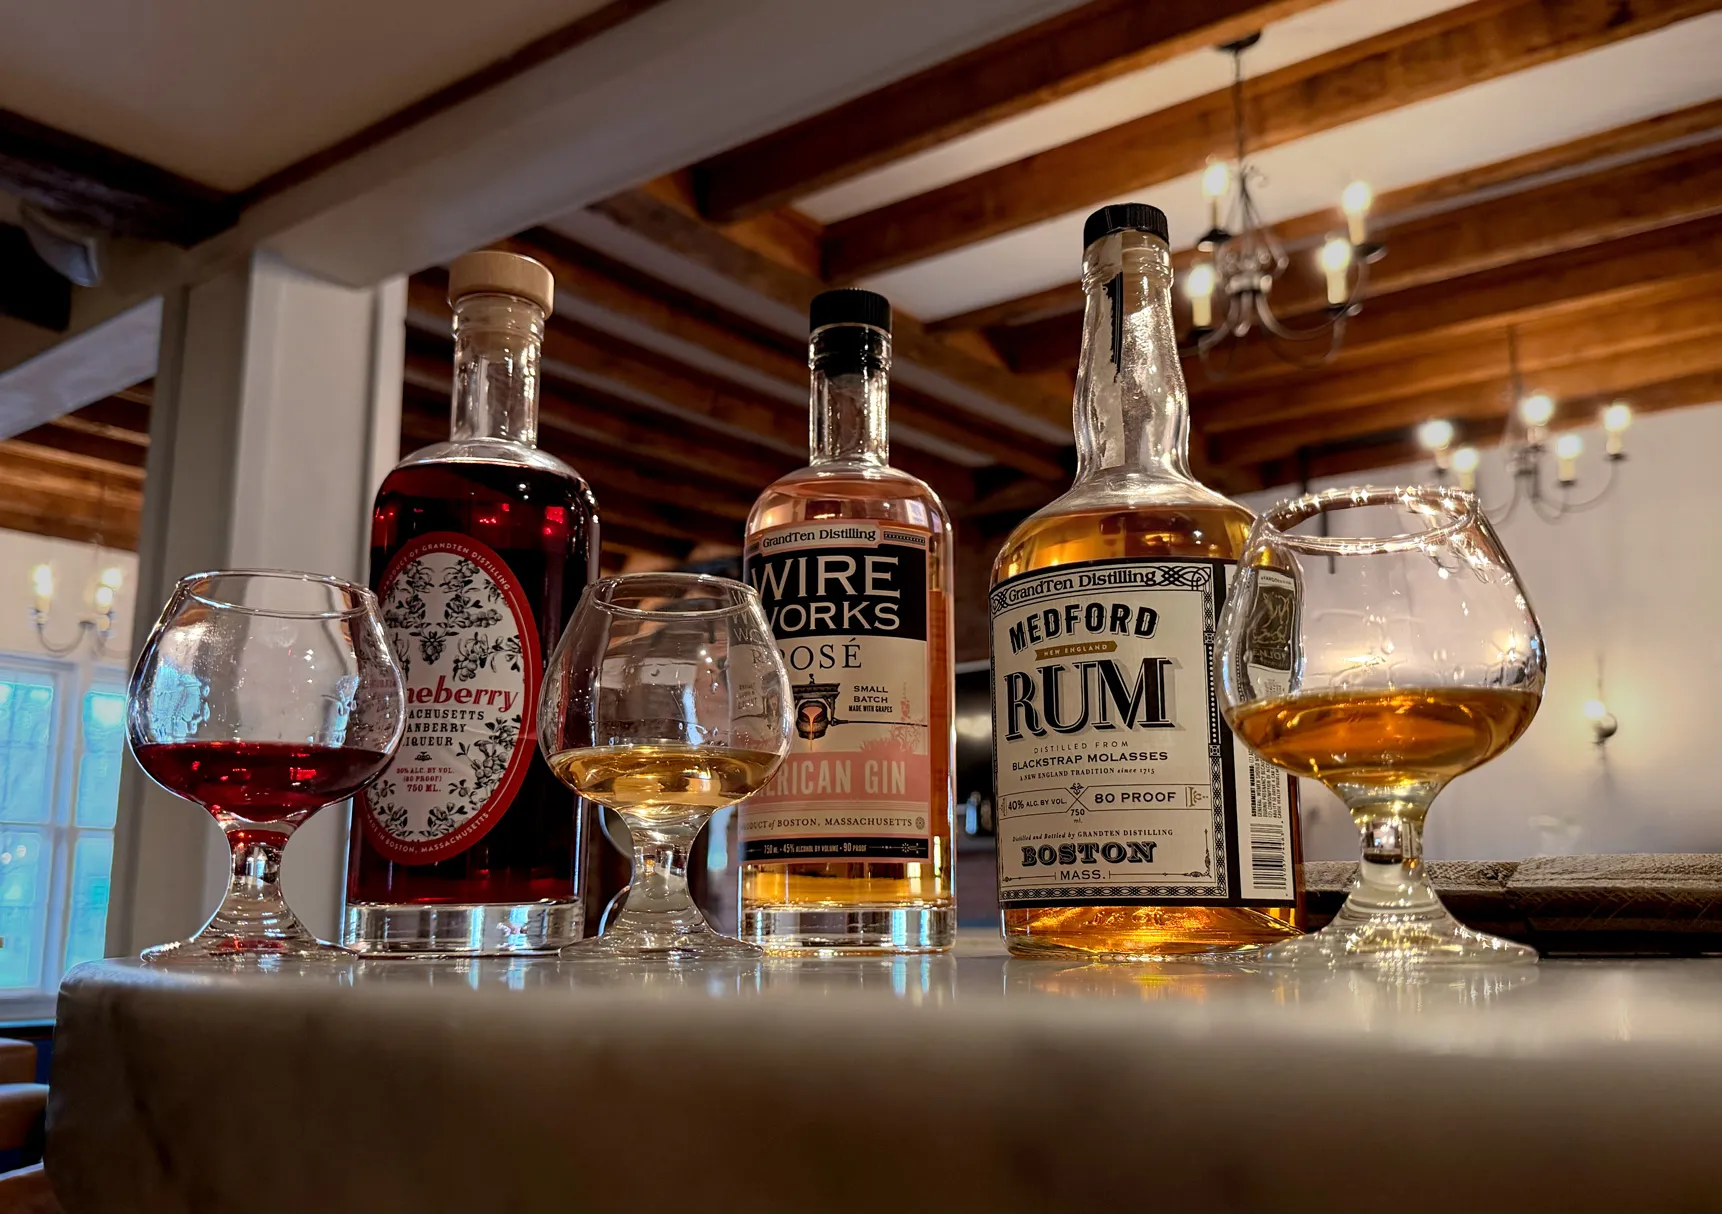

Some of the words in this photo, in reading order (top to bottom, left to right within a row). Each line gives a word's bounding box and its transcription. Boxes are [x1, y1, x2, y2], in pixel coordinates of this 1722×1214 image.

[763, 531, 816, 548] GrandTen
[819, 528, 876, 541] Distilling
[409, 549, 419, 557] OF
[422, 542, 470, 553] GRANDTEN
[471, 551, 511, 590] DISTILLING
[751, 554, 900, 601] WIRE
[1009, 576, 1074, 602] GrandTen
[1078, 570, 1157, 588] Distilling
[1009, 602, 1160, 655] MEDFORD
[780, 637, 862, 670] OSÉ
[1043, 647, 1061, 657] NEW
[1064, 643, 1109, 654] ENGLAND
[853, 685, 889, 694] SMALL
[853, 696, 888, 704] BATCH
[1004, 657, 1179, 742] RUM
[408, 709, 485, 720] ACHUSETTS
[875, 705, 893, 713] GRAPES
[406, 723, 467, 734] ANBERRY
[402, 737, 454, 747] IQUEUR
[1033, 743, 1088, 755] DISTILLED
[1095, 740, 1129, 749] FROM
[1012, 755, 1083, 771] BLACKSTRAP
[1087, 751, 1168, 764] MOLASSES
[864, 760, 906, 795] GIN
[1038, 770, 1068, 779] ENGLAND
[1071, 767, 1115, 777] TRADITION
[407, 784, 423, 792] 750
[1094, 793, 1115, 804] 80
[1121, 791, 1176, 803] PROOF
[1008, 799, 1025, 811] 40%
[1070, 808, 1085, 816] 750
[768, 819, 776, 830] of
[824, 817, 913, 827] MASSACHUSETTS
[421, 812, 489, 853] MASSACHUSETTS
[1067, 831, 1075, 840] by
[1077, 829, 1121, 838] GRANDTEN
[1123, 829, 1173, 837] DISTILLING
[783, 843, 795, 853] 45%
[814, 845, 821, 853] BY
[843, 842, 852, 852] 90
[1021, 840, 1157, 867] BOSTON
[1060, 869, 1106, 881] MASS.
